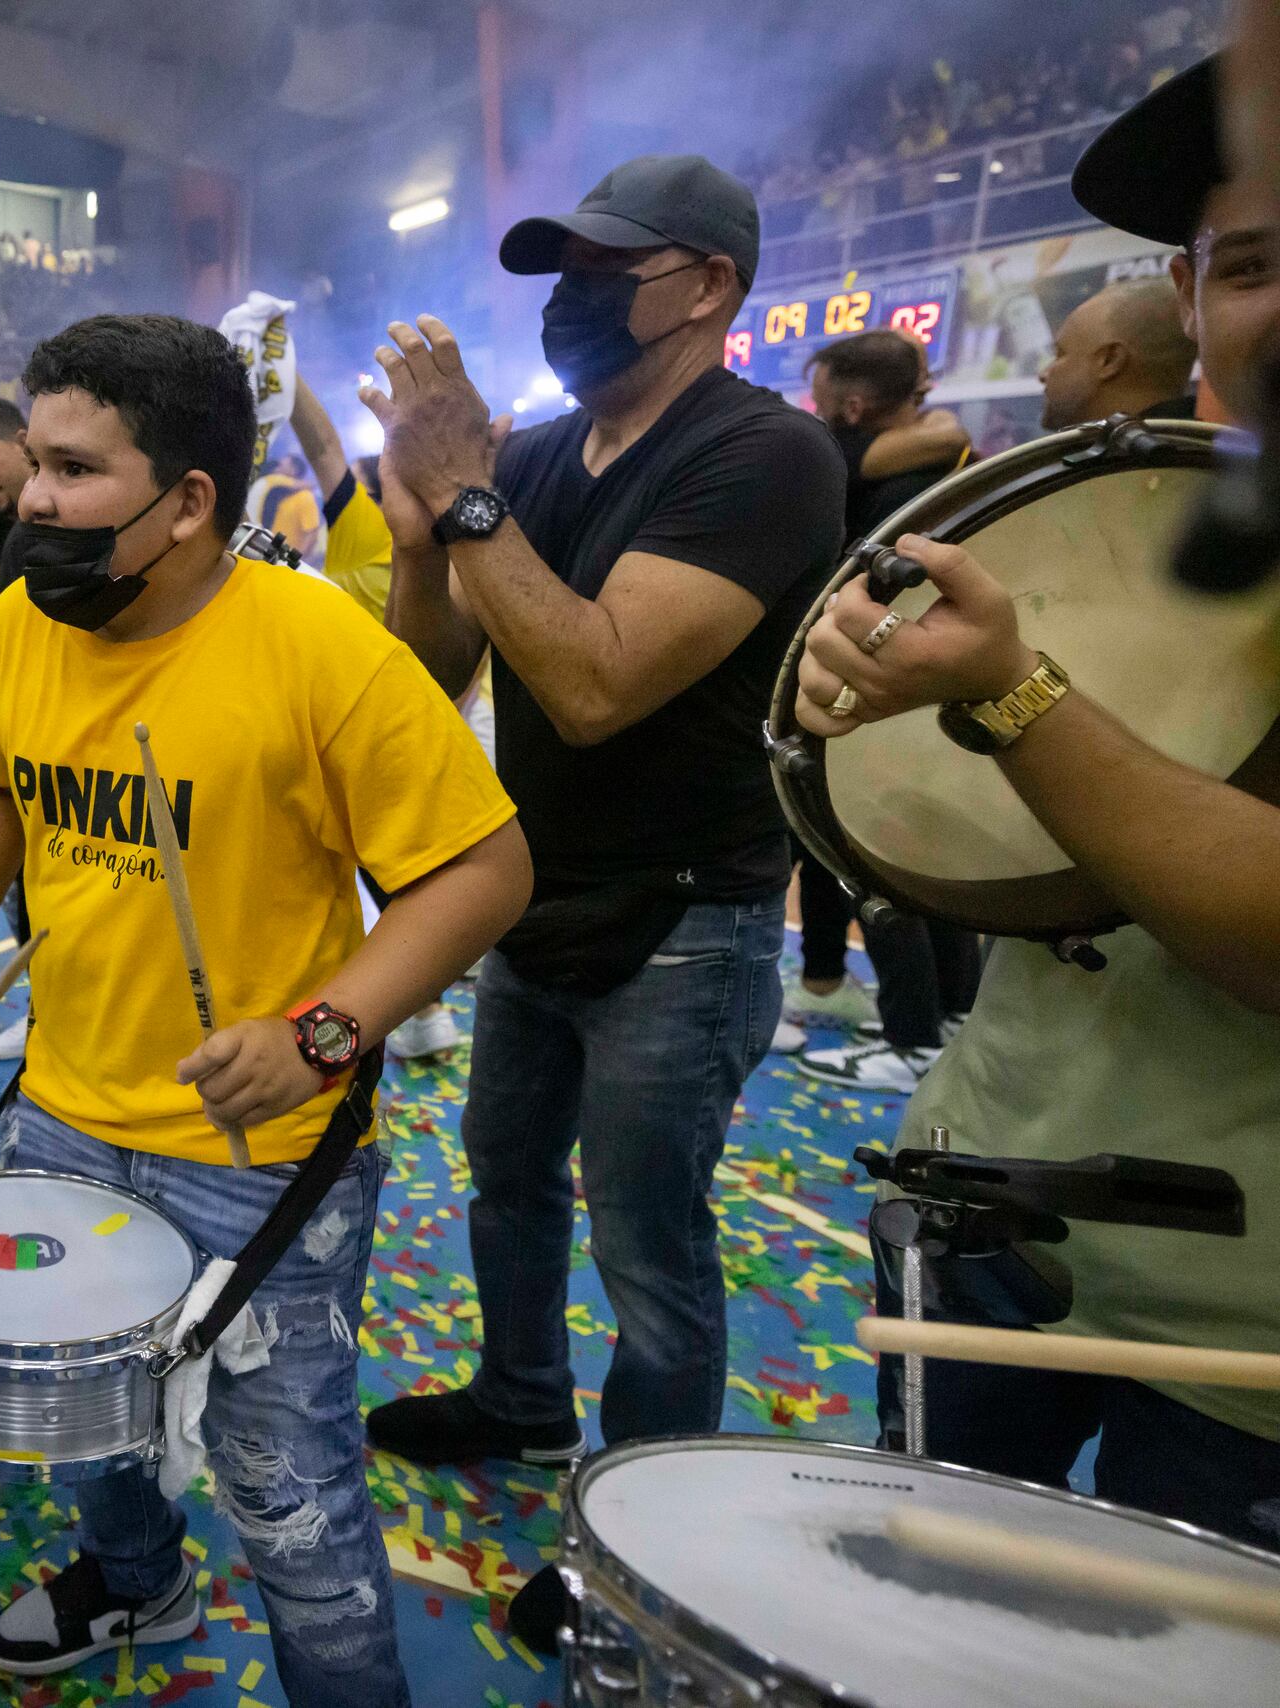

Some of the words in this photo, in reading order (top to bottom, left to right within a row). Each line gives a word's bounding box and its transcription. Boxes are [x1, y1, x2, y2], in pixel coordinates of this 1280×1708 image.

[764, 302, 808, 344] 09
[824, 291, 871, 335] 02
[14, 755, 193, 850] PINKIN
[47, 824, 65, 858] de
